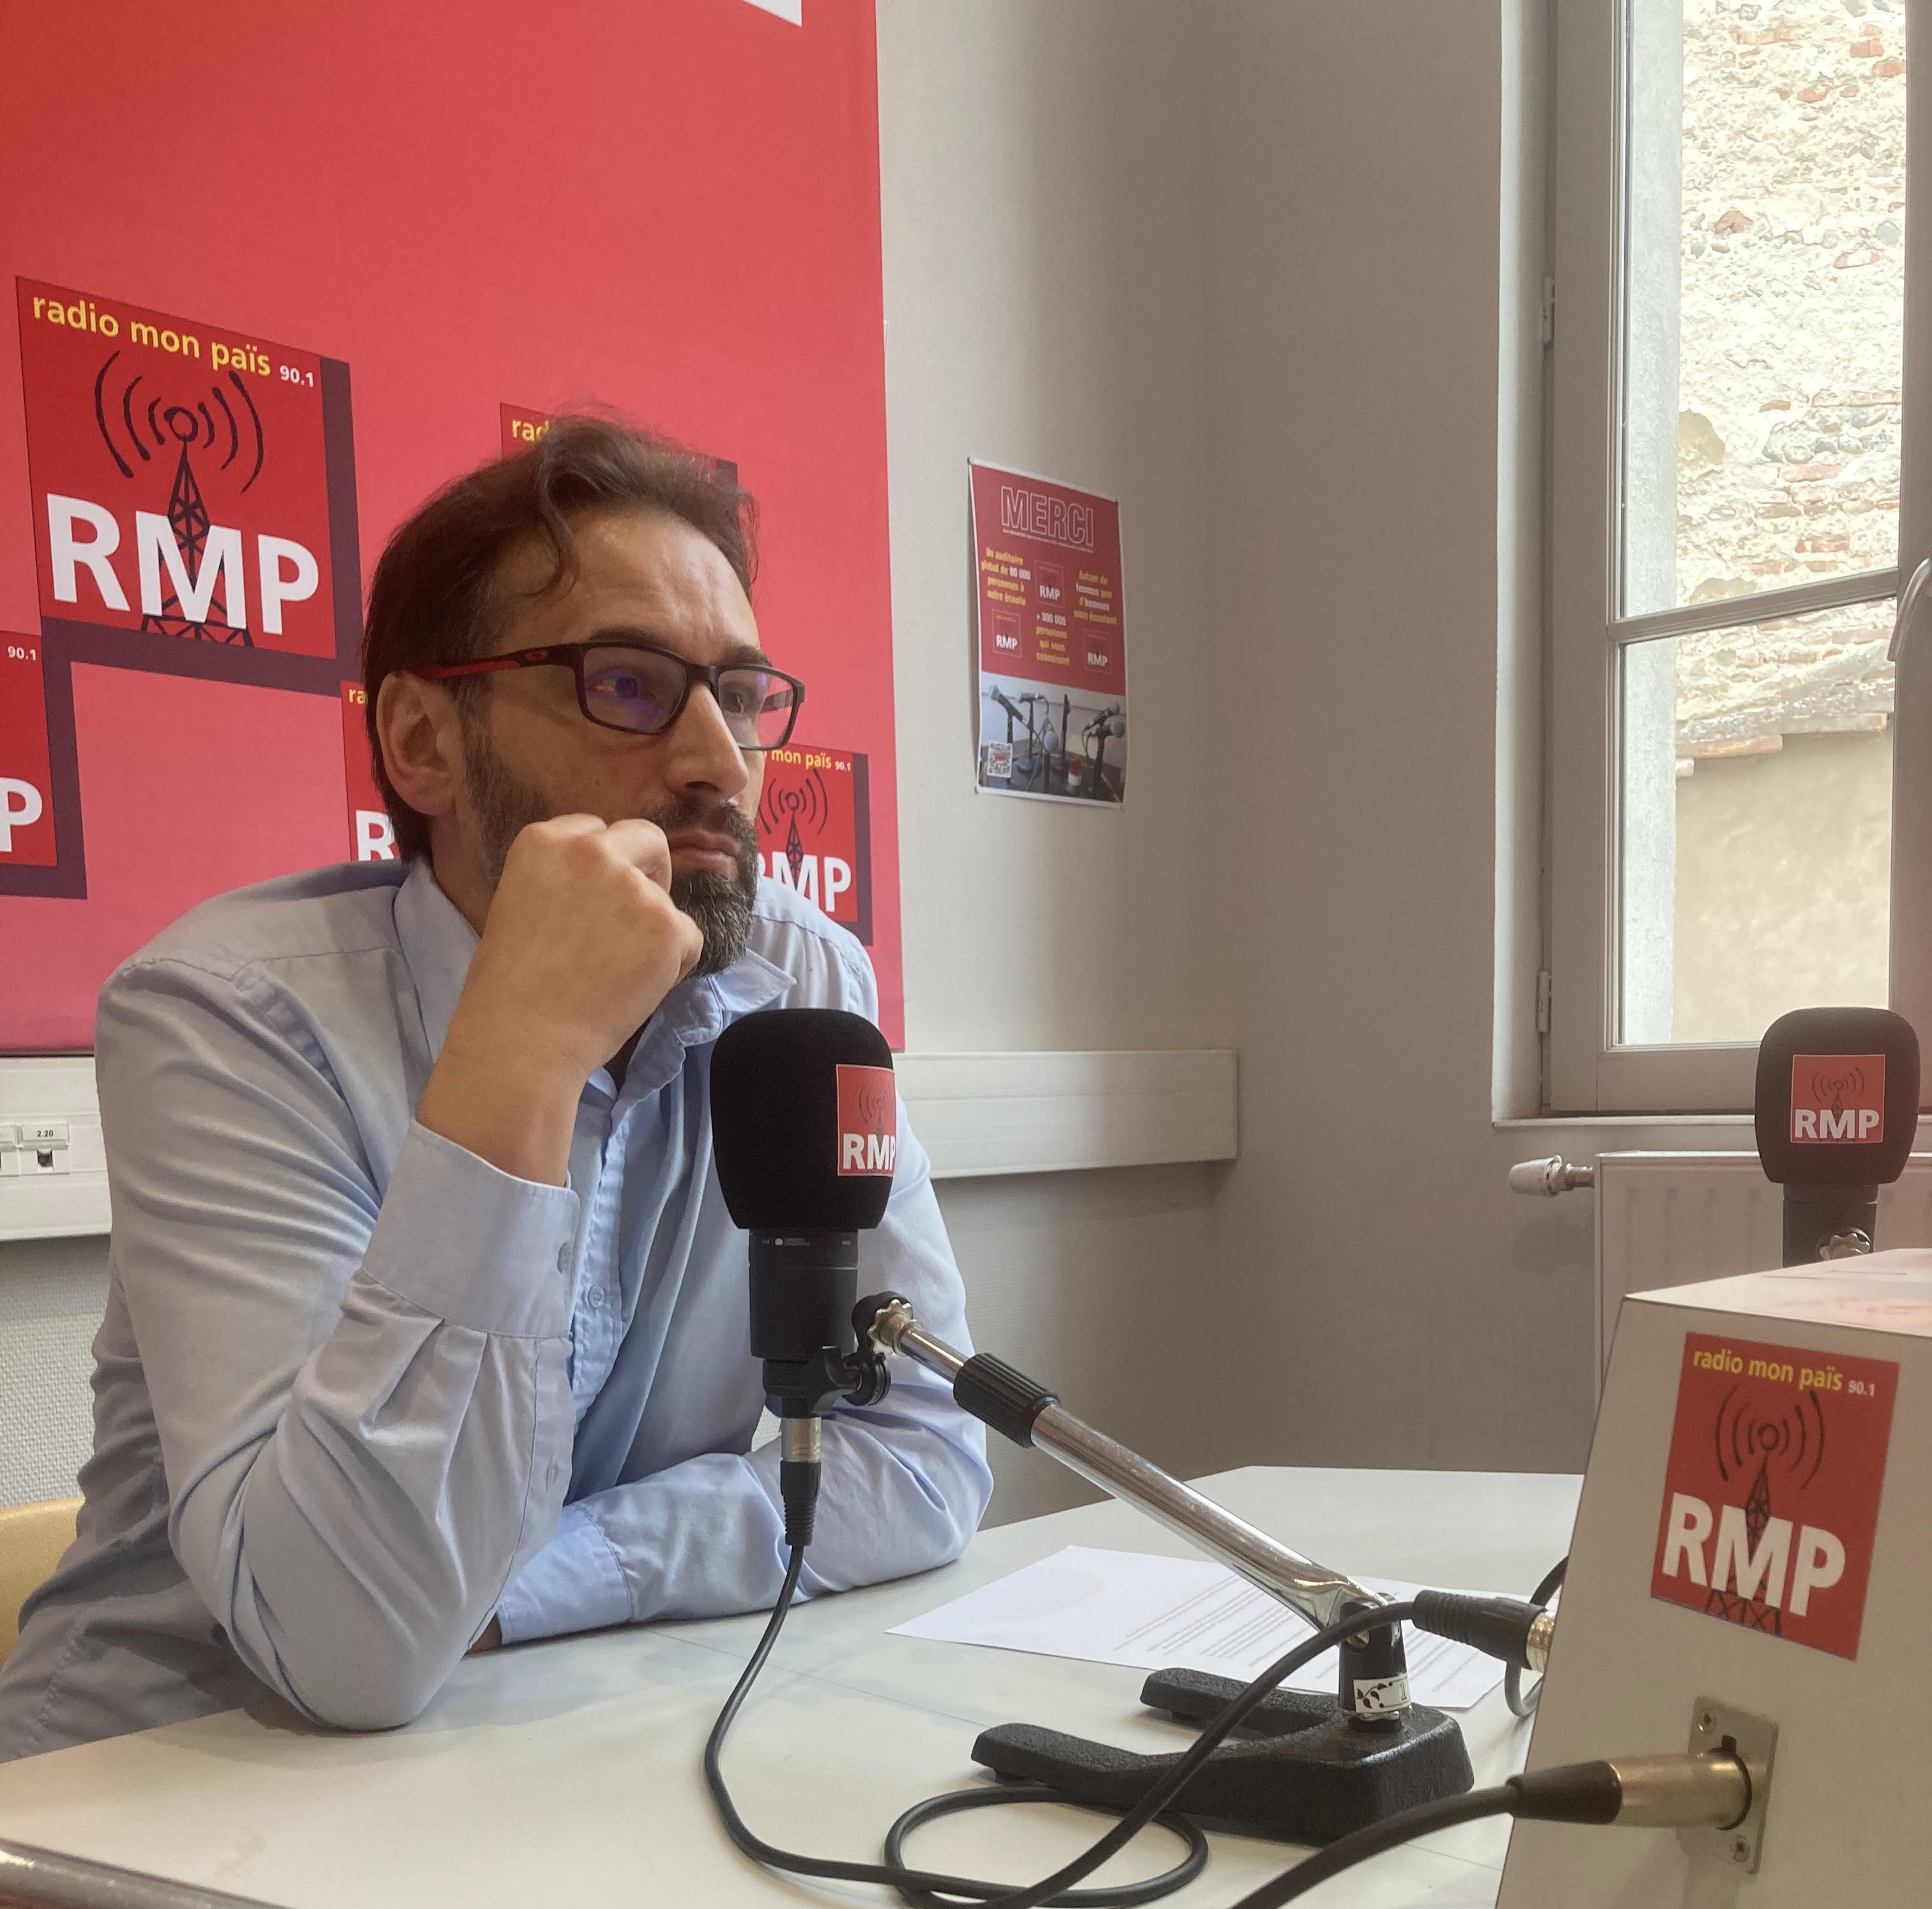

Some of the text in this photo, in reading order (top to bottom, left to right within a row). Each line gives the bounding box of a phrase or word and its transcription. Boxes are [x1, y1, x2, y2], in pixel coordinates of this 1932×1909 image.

[33, 296, 314, 387] radio mon païs 90.1
[1001, 486, 1094, 547] MERCI
[47, 493, 319, 636] RMP
[1039, 585, 1061, 601] RMP
[7, 646, 37, 661] 90.1
[996, 634, 1018, 650] RMP
[1087, 652, 1108, 668] RMP
[770, 749, 851, 771] mon païs 90.1
[1795, 1109, 1880, 1139] RMP
[1694, 1349, 1876, 1397] radio mon païs 90.1
[1662, 1492, 1846, 1617] RMP
